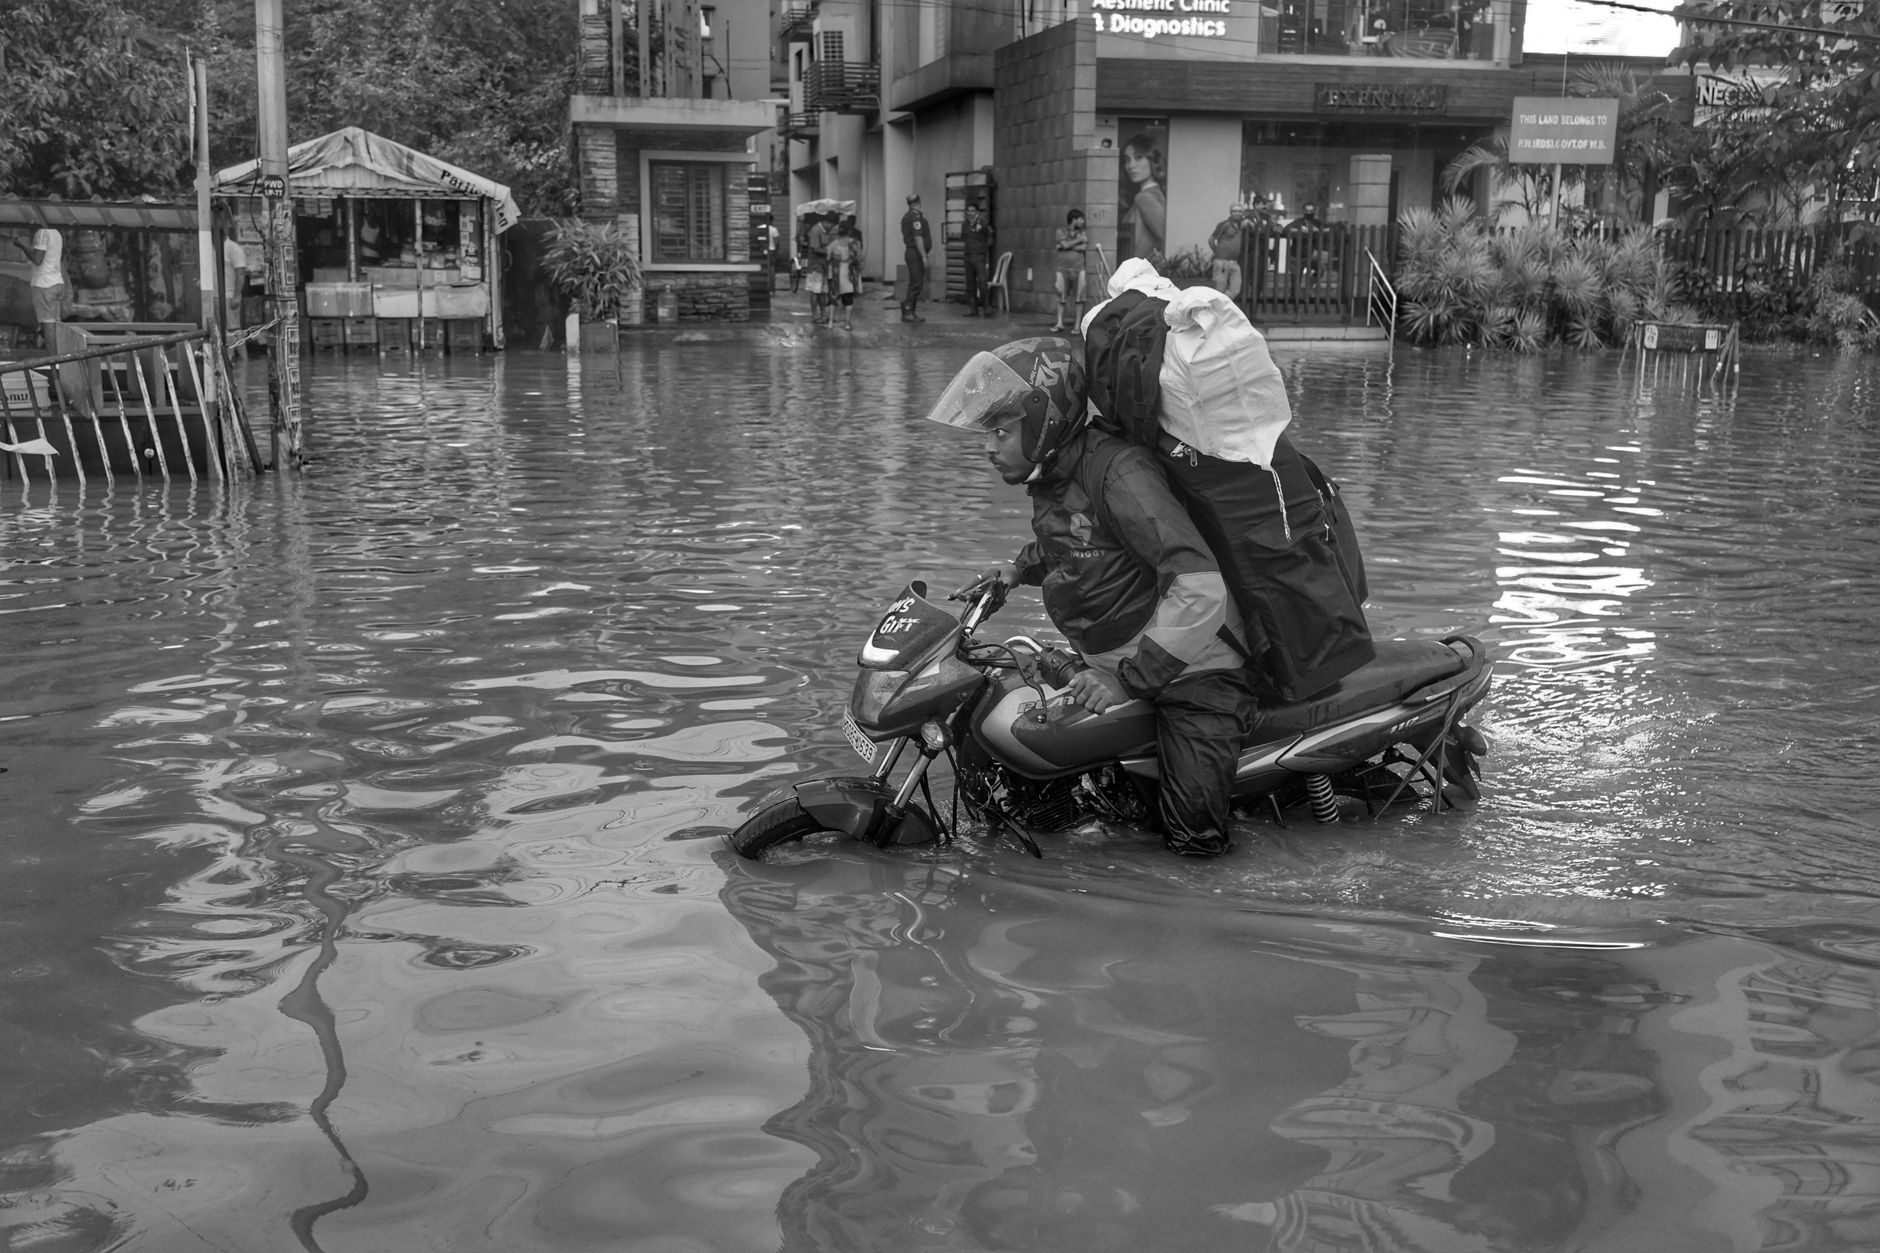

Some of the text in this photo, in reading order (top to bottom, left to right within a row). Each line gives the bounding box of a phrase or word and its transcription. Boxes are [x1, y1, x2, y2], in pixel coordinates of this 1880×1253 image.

[1110, 13, 1226, 39] Diagnostics
[1519, 114, 1607, 126] THIS LAND BELONGS TO
[264, 180, 283, 188] PWD
[880, 615, 920, 634] GIFT
